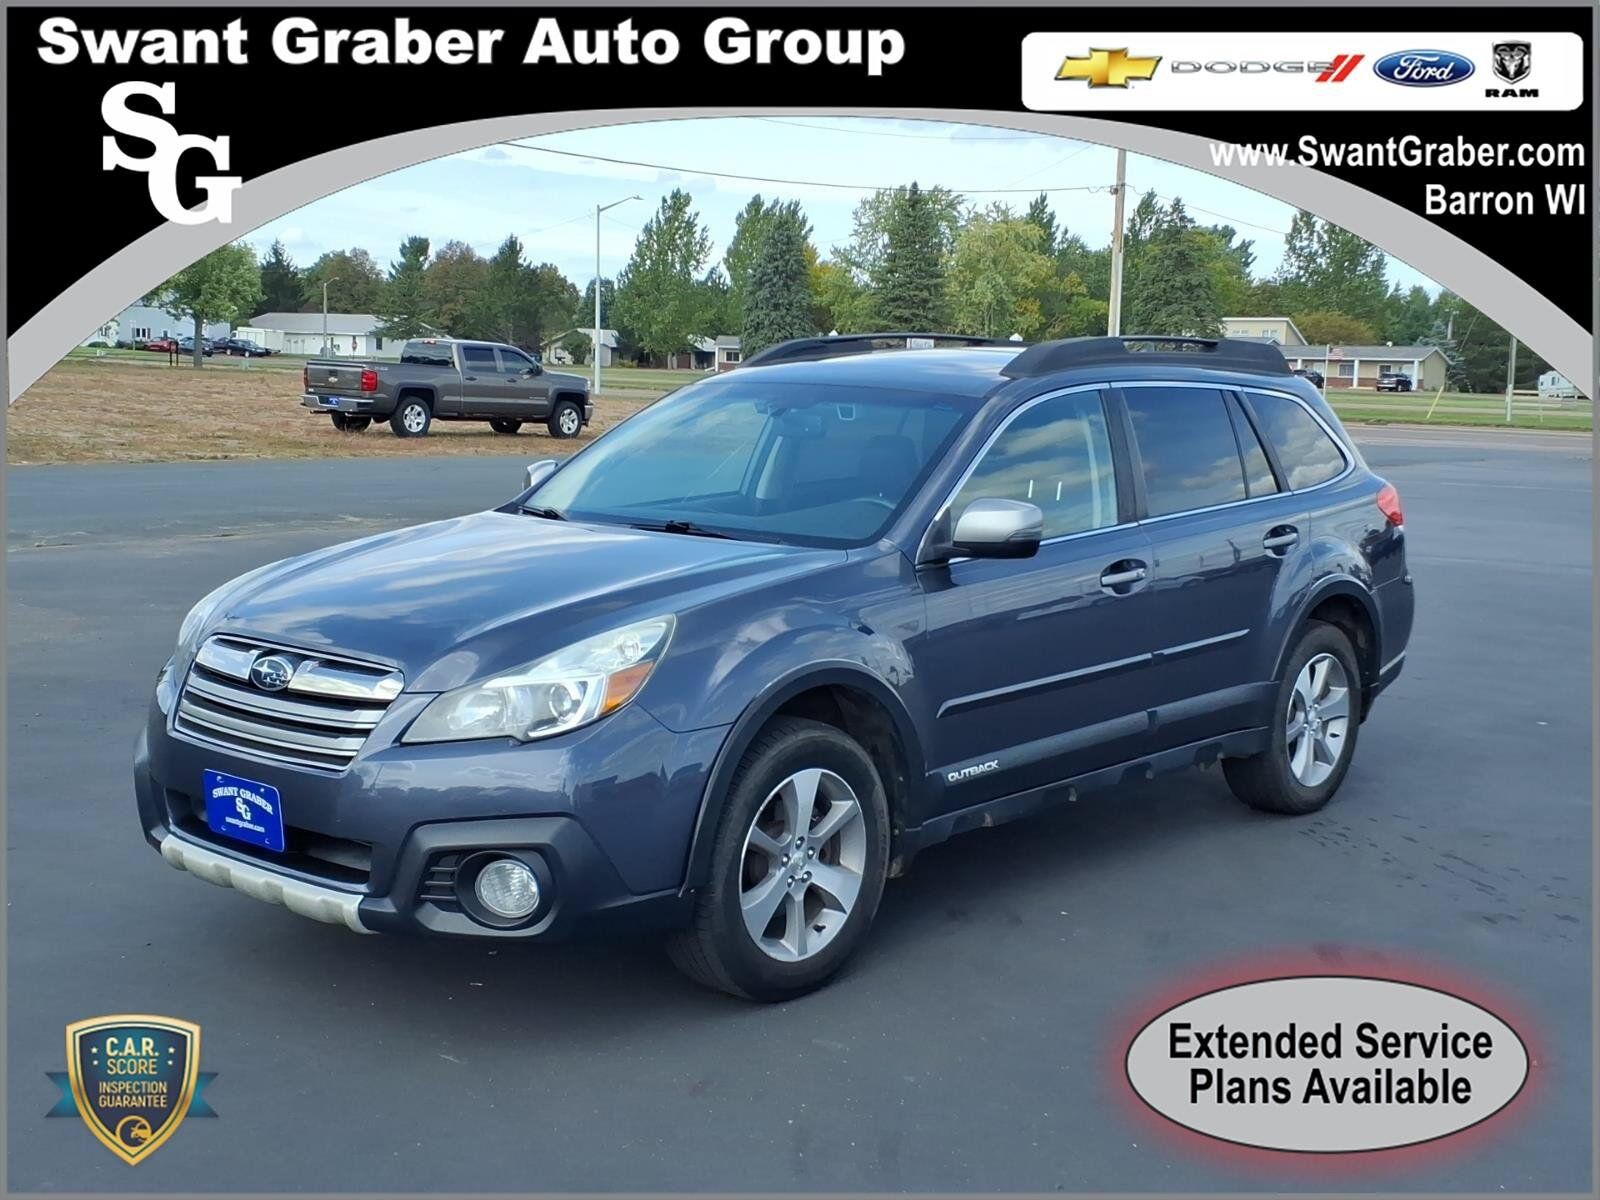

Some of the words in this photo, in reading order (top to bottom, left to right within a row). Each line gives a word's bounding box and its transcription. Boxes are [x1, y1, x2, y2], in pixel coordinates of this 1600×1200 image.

[947, 760, 999, 782] OUTBACK
[212, 787, 238, 798] SWANT
[240, 788, 273, 815] GRABER
